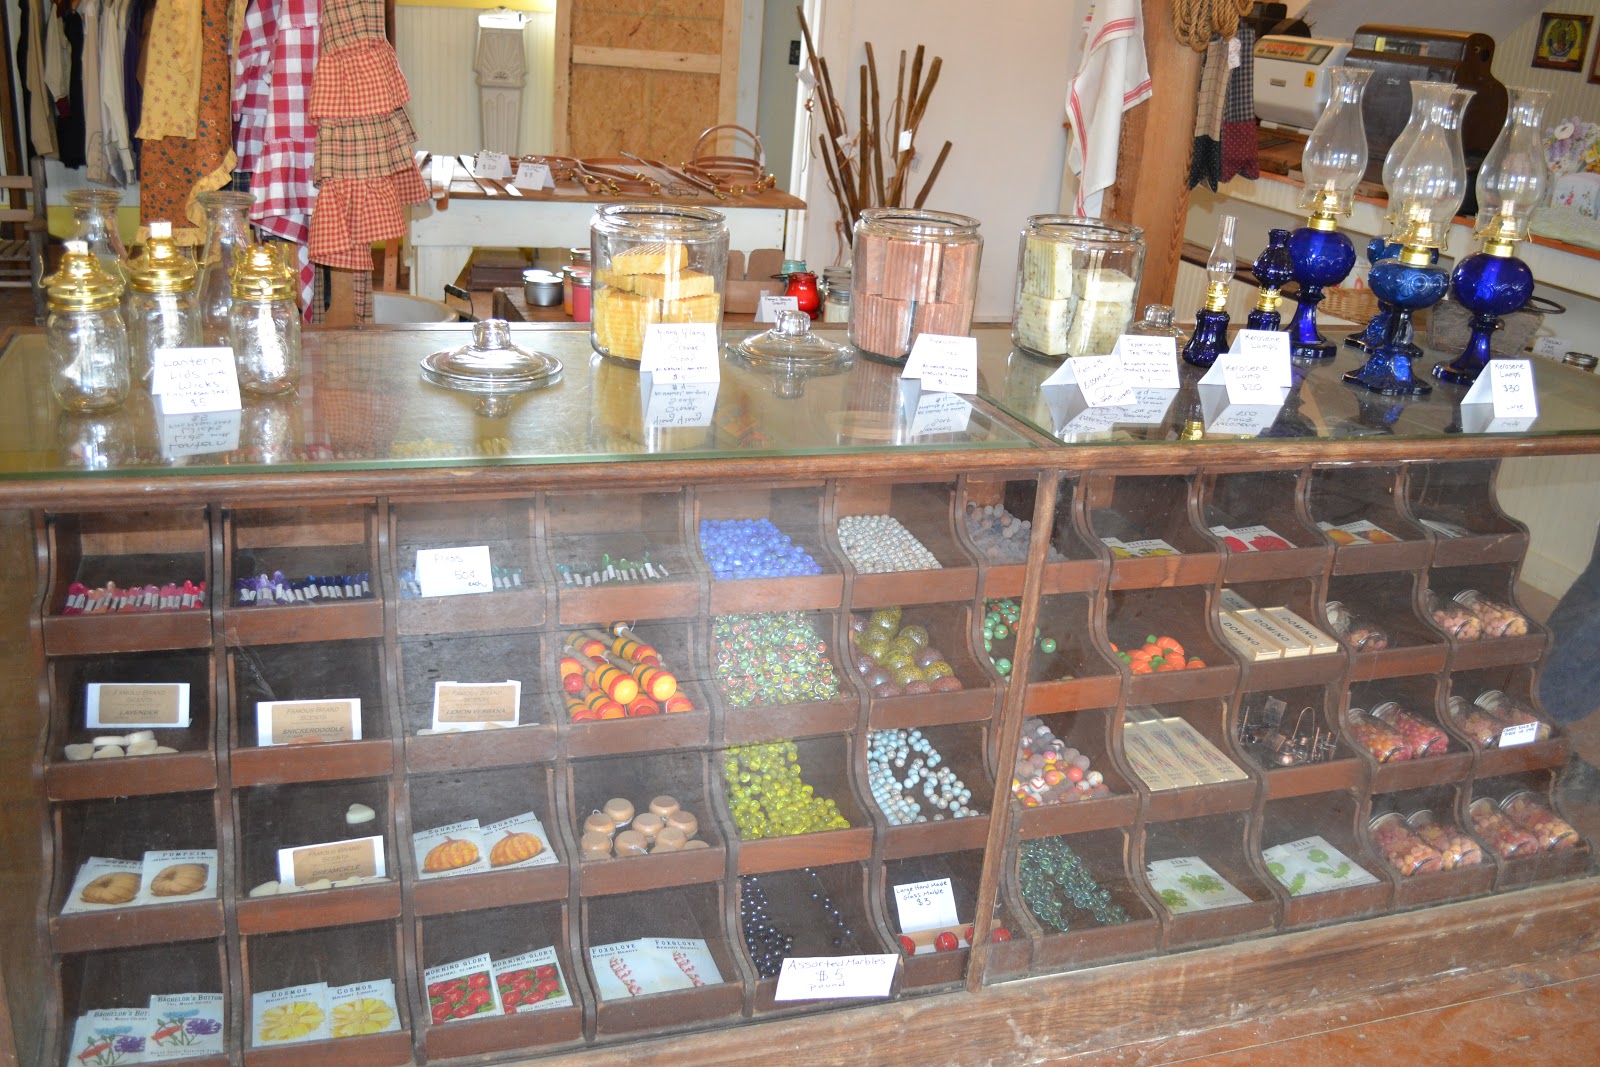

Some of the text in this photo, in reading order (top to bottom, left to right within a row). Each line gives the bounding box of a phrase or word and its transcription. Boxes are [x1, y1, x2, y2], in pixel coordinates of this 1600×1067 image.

[164, 355, 222, 367] Lantern
[1495, 362, 1525, 370] Kerosene
[1225, 364, 1269, 372] Kerosene
[1235, 372, 1261, 381] Lamp
[179, 380, 220, 390] Wicks
[1502, 384, 1521, 393] $30
[1254, 618, 1290, 642] DOMINO
[1282, 616, 1318, 640] DOMINO
[1223, 622, 1260, 646] DOMINO
[282, 726, 345, 735] SNICKERDOODLE
[428, 823, 463, 835] SQUASH
[486, 817, 520, 831] SQUASH
[903, 888, 944, 900] Glass Marble
[916, 897, 932, 906] $3
[592, 943, 637, 954] FOXGLOVE
[492, 948, 554, 969] MORNING GLORY
[788, 957, 887, 970] Assorted Marbles
[425, 956, 489, 977] MORNING GLORY
[336, 984, 373, 995] COSMOS
[808, 980, 846, 991] pound
[271, 987, 308, 998] COSMOS
[157, 995, 196, 1003] BACHELOR'S
[94, 1010, 133, 1018] BACHELOR'S
